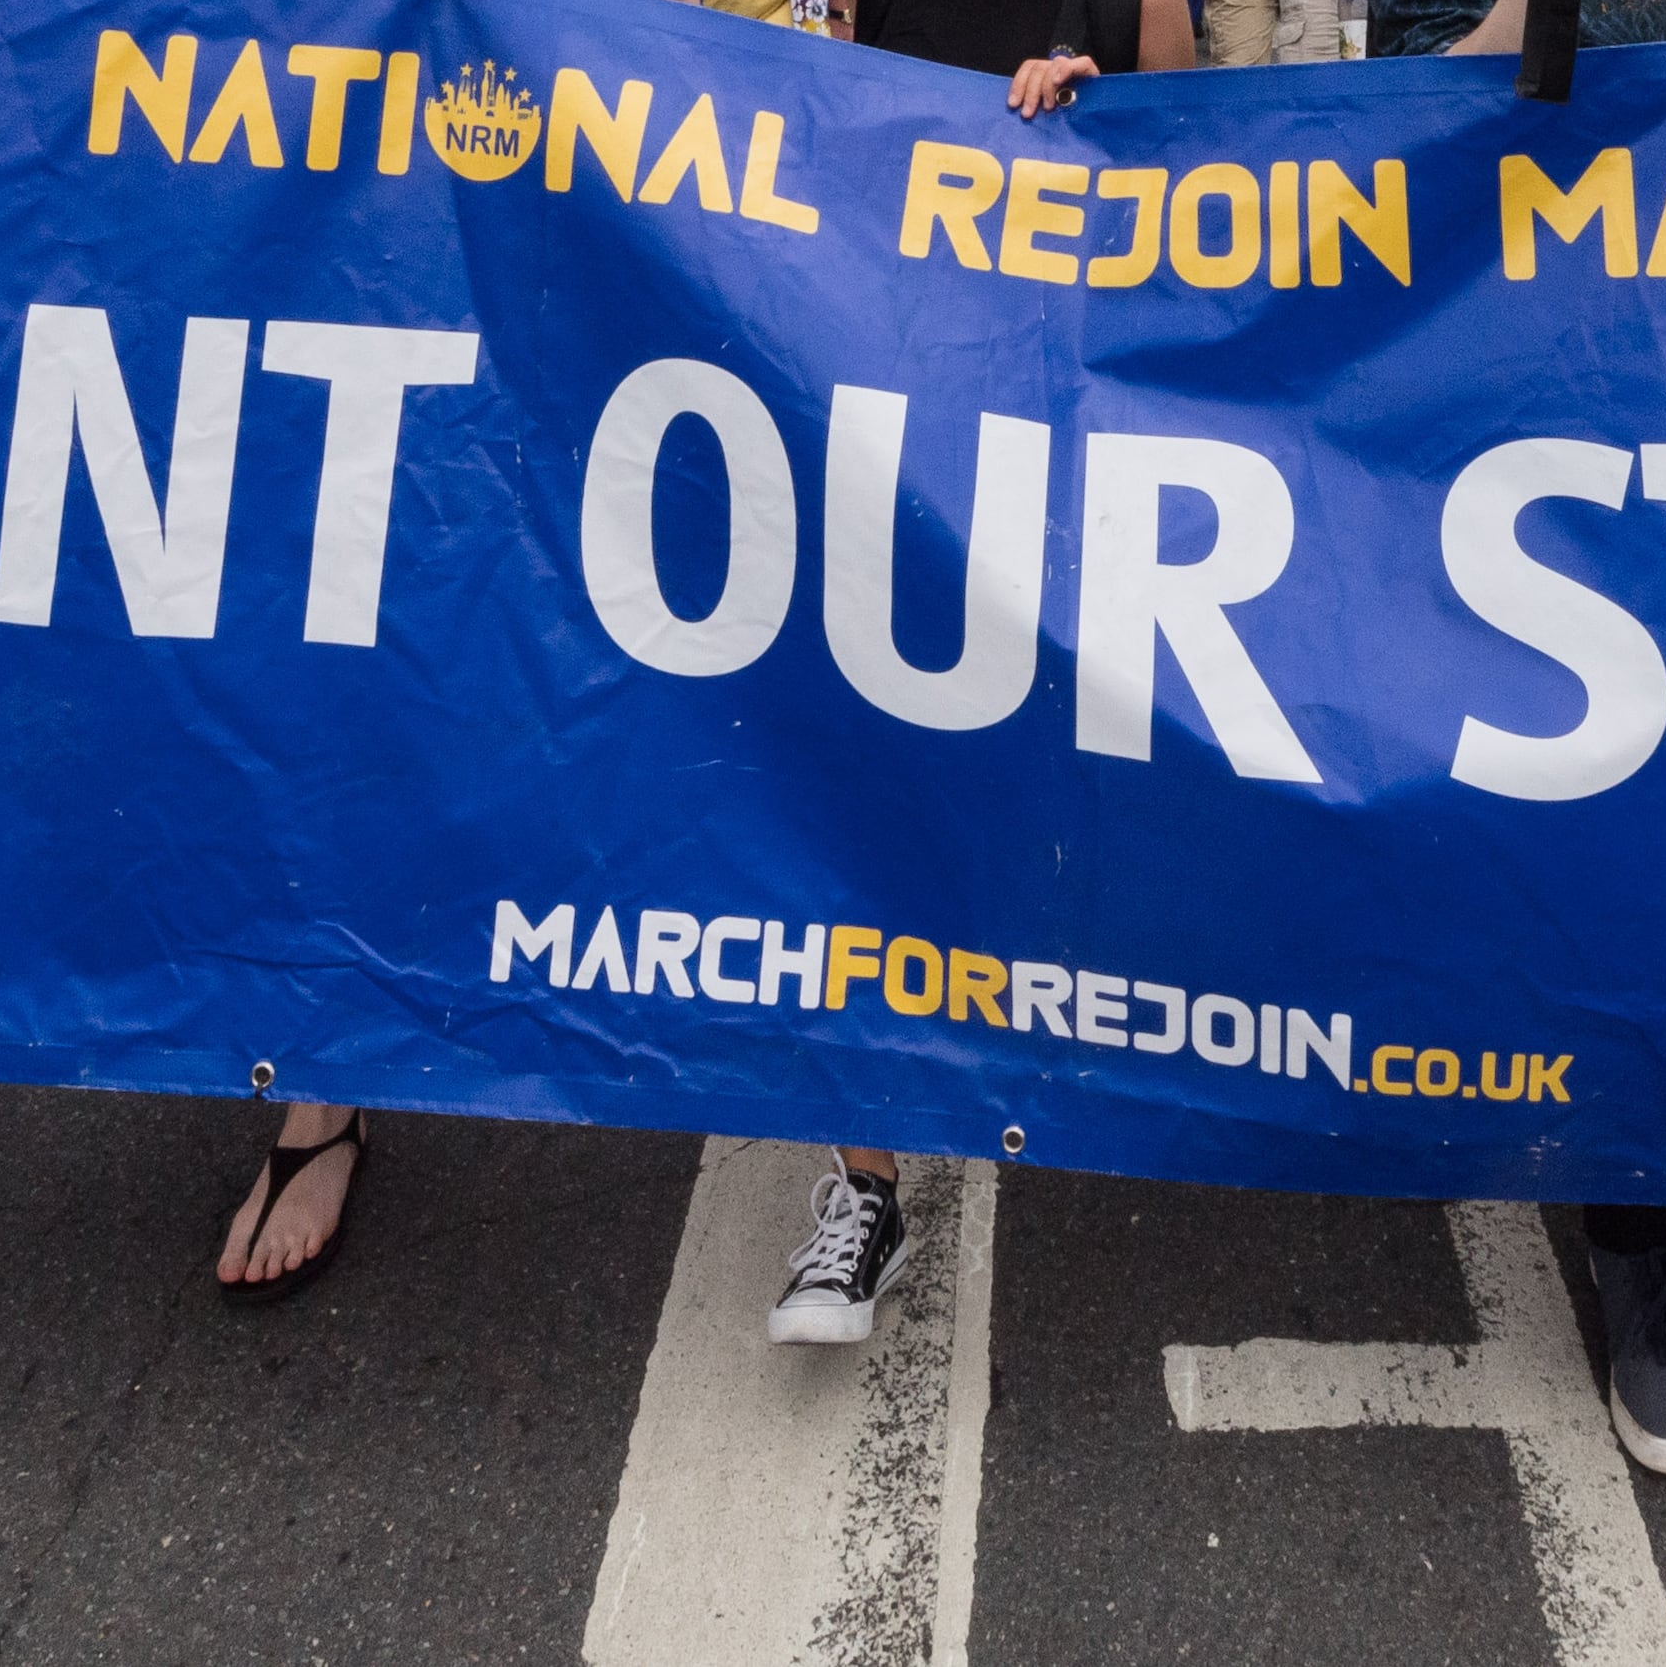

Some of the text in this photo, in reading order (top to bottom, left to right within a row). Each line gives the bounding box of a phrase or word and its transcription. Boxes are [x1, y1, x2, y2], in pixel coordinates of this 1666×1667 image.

[445, 122, 520, 159] NRM
[899, 139, 1412, 289] REJOIN
[580, 357, 1324, 784] OUR
